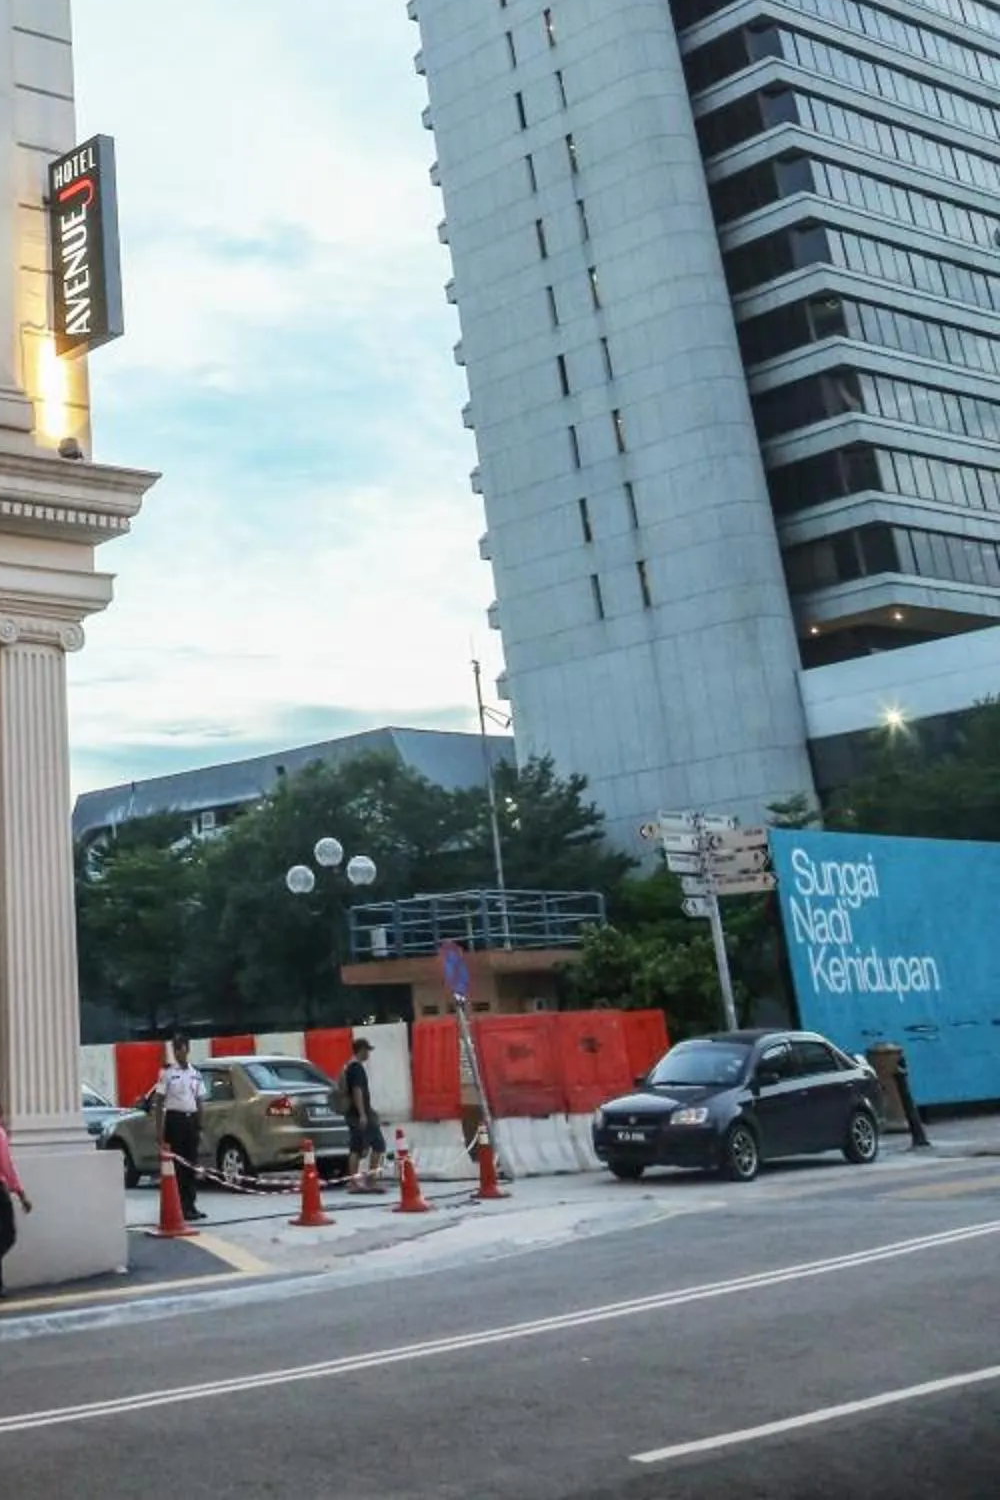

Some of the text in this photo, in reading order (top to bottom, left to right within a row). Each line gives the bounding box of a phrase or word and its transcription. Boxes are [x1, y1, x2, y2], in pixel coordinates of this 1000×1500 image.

[53, 147, 96, 189] HOTEL
[59, 179, 93, 335] AVENUE J
[791, 848, 879, 908] Sungai
[789, 895, 853, 945] Nadi
[808, 946, 941, 1003] Kehidupan
